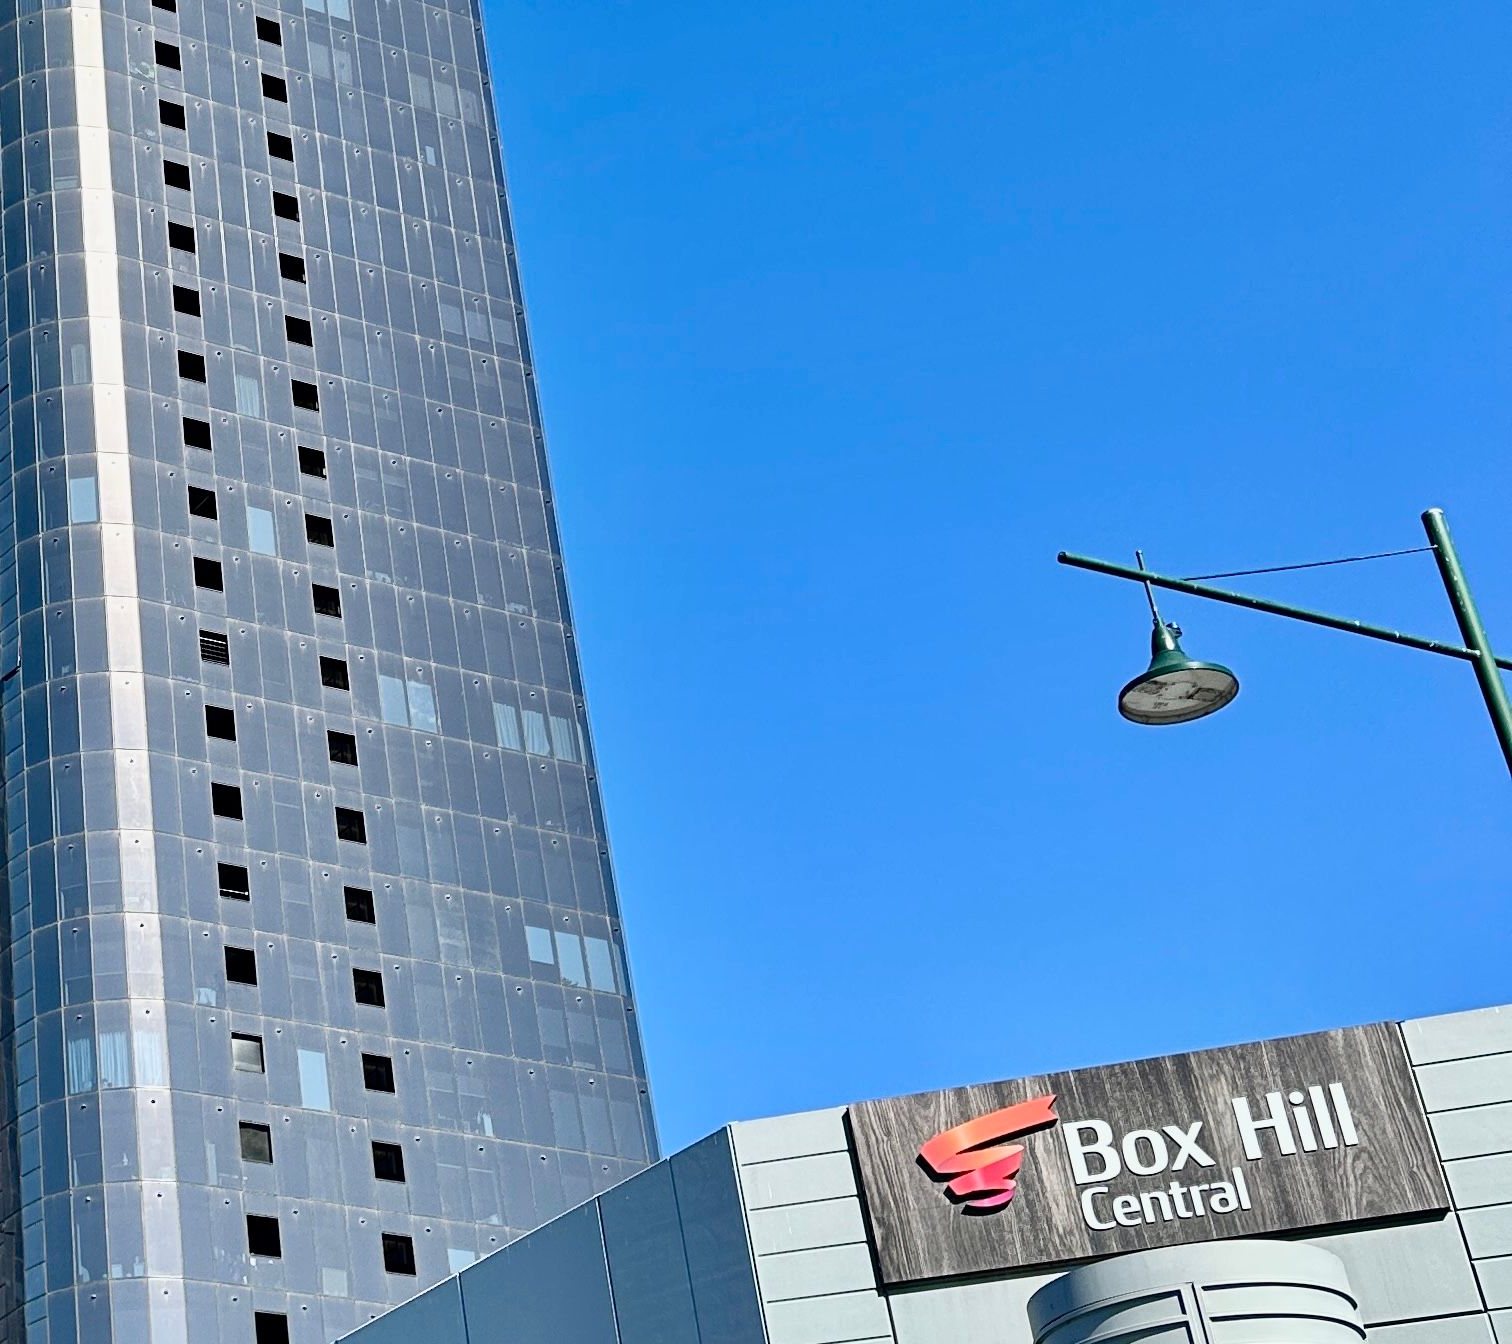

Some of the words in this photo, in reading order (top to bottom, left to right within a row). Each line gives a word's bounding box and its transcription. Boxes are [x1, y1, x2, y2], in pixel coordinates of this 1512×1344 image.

[1062, 1118, 1216, 1186] Box
[1231, 1082, 1360, 1161] Hill
[1080, 1166, 1252, 1230] Central
